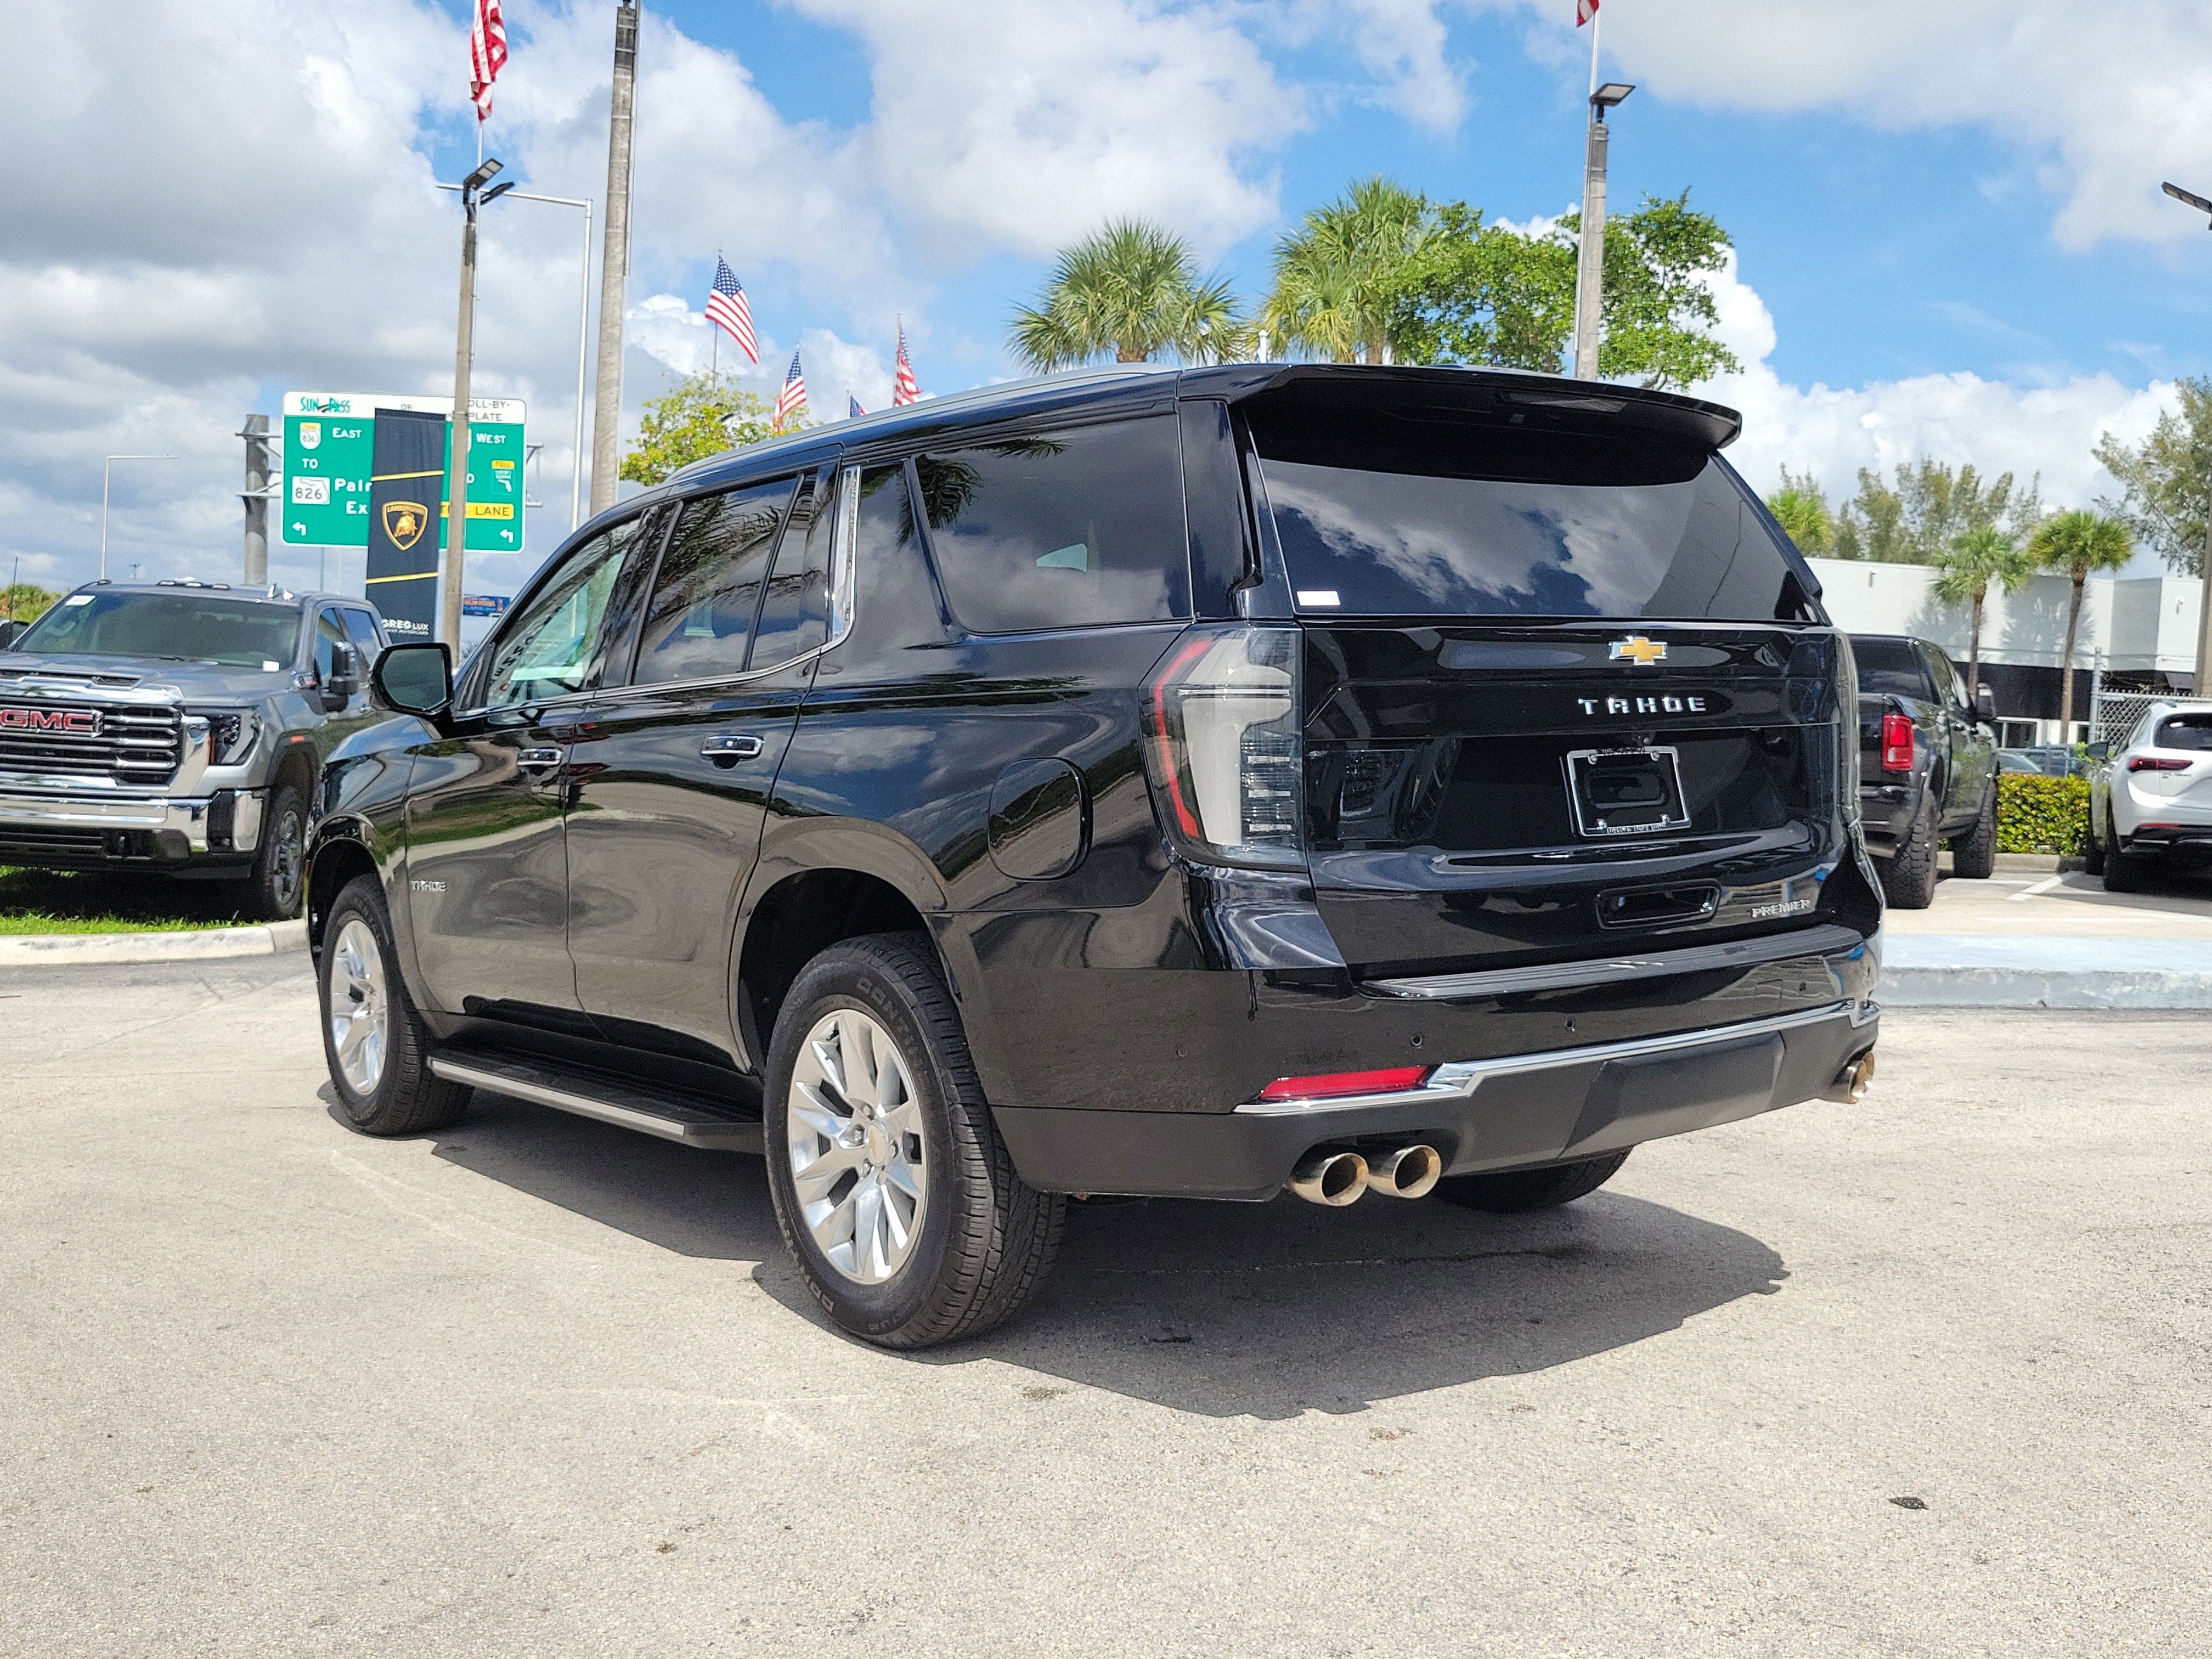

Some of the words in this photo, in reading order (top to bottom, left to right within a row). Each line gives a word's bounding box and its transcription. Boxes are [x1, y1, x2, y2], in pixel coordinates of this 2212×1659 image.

[467, 399, 510, 408] OLL-BY-
[468, 412, 502, 421] PLATE
[332, 427, 362, 438] EAST
[476, 432, 506, 444] WEST
[302, 458, 319, 469] TO
[295, 487, 322, 500] 826
[476, 506, 510, 517] LANE
[412, 622, 429, 630] LUX
[1578, 696, 1707, 715] TAHOE
[0, 709, 94, 732] GMC
[411, 880, 447, 892] TAHOE
[1752, 899, 1811, 918] PREMIER
